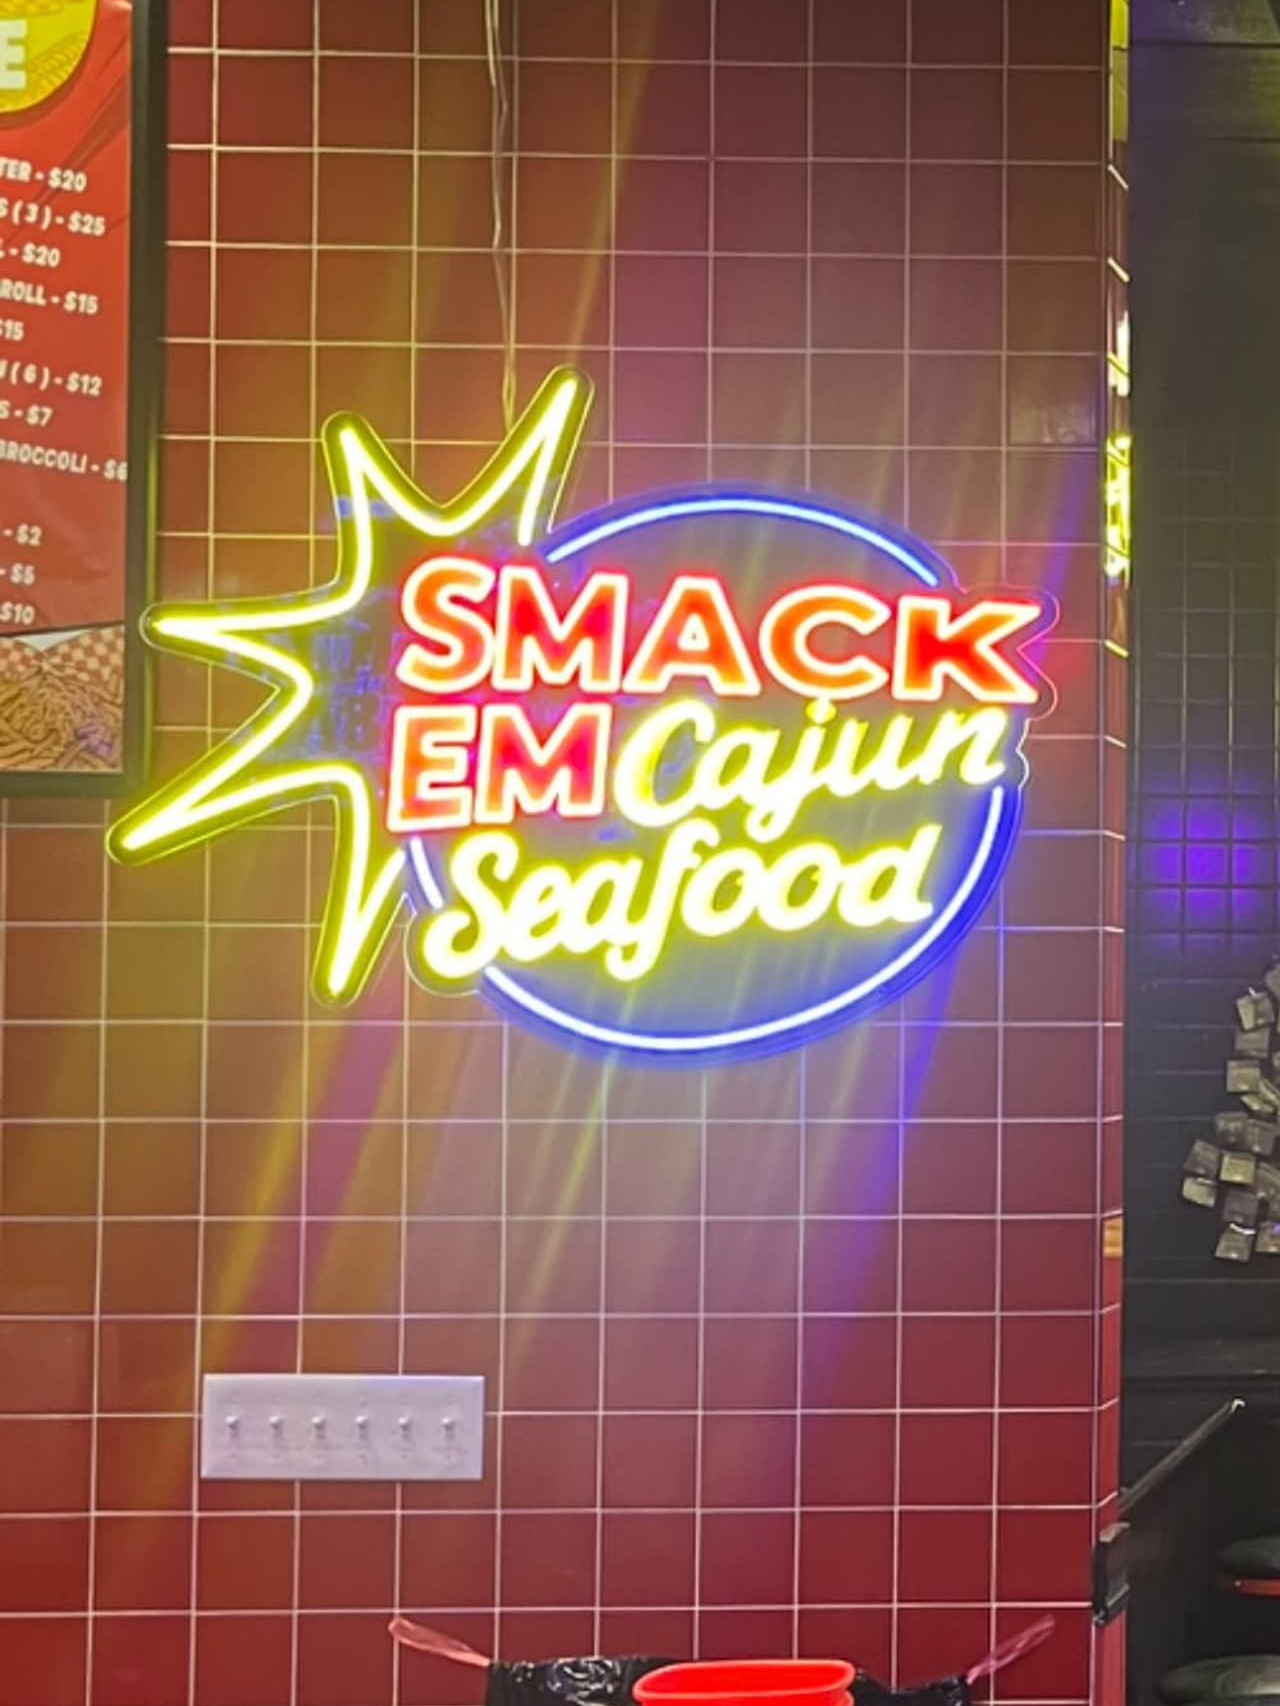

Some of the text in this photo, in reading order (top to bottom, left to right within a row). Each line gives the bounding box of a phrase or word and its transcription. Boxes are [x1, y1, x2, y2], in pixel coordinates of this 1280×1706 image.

[48, 166, 87, 193] $20
[67, 210, 106, 237] $25
[22, 242, 61, 268] $20
[63, 290, 99, 315] $15
[66, 371, 103, 398] $12
[26, 404, 53, 427] $7
[16, 522, 42, 547] $2
[10, 563, 36, 586] $5
[0, 601, 35, 625] $10
[396, 554, 1044, 705] SMACK
[387, 695, 1007, 834] EM Cajun
[421, 821, 944, 984] Seafood
